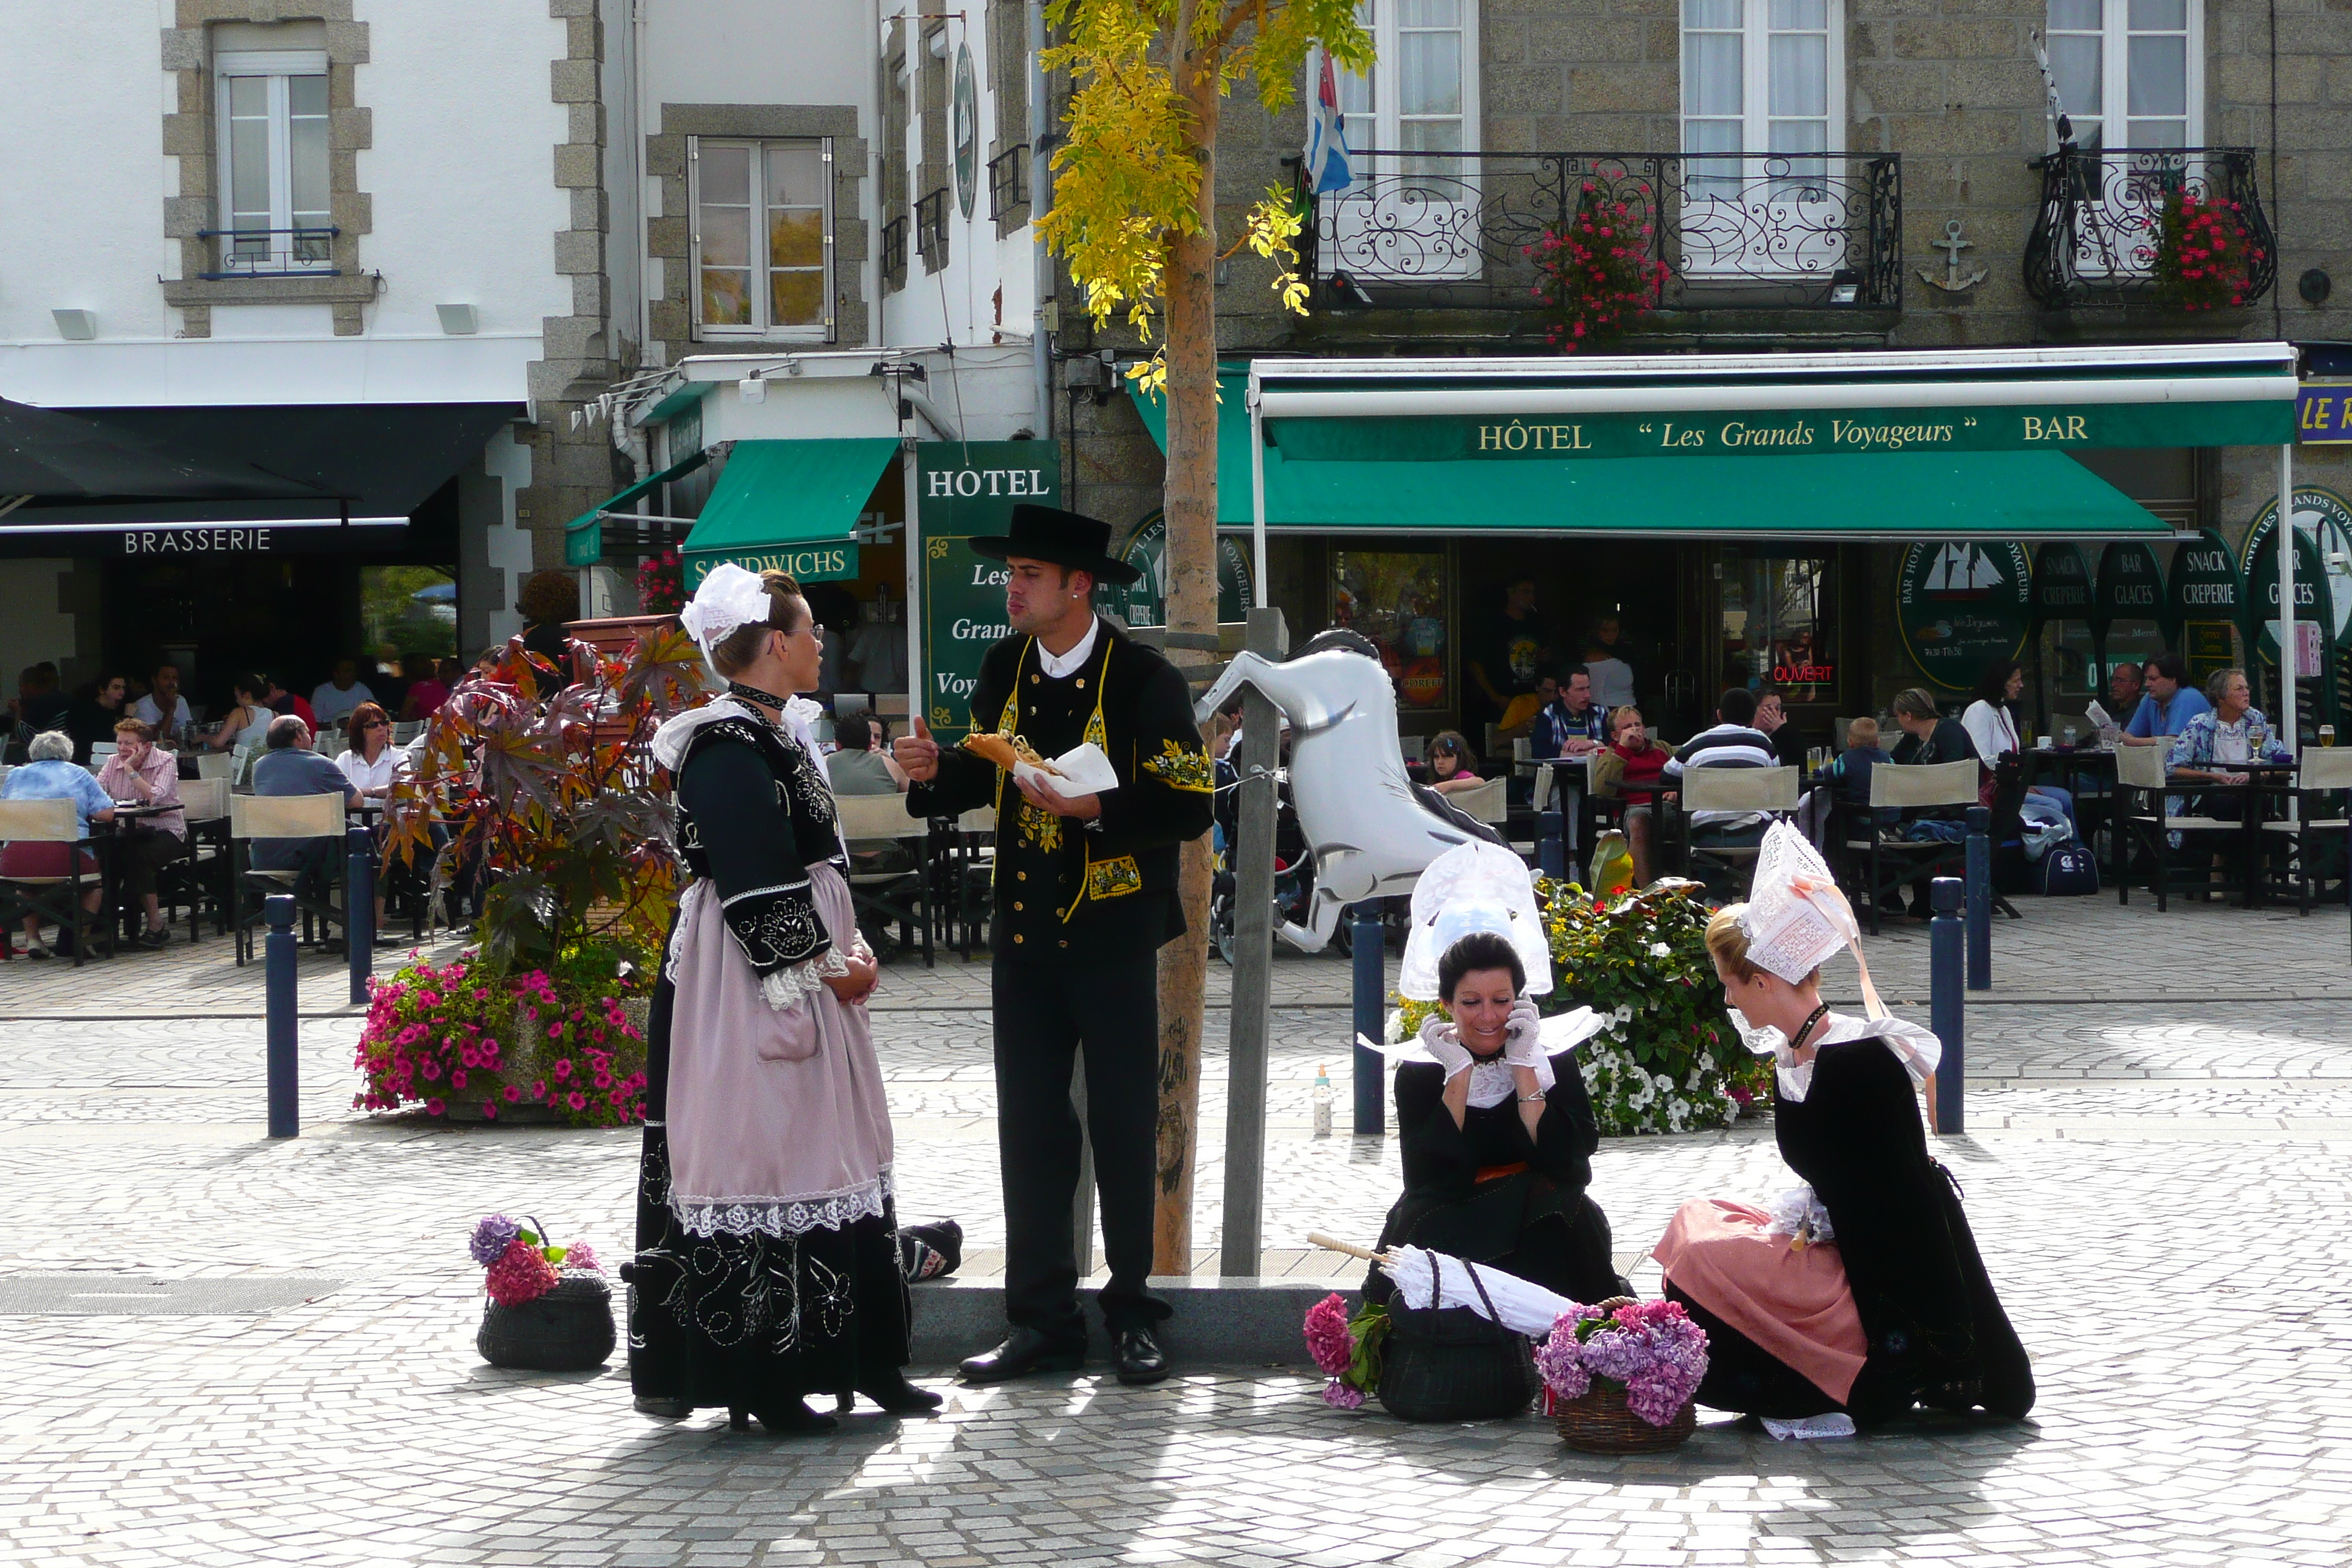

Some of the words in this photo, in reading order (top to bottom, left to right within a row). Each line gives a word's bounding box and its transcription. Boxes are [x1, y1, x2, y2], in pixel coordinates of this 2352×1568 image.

[2302, 397, 2333, 429] LE
[1478, 418, 1592, 450] HÔTEL
[1661, 423, 1705, 448] Les
[1721, 420, 1814, 446] Grands
[1831, 418, 1954, 450] Voyageurs
[2022, 415, 2089, 440] BAR
[927, 469, 1050, 497] HOTEL
[2258, 512, 2277, 534] LES
[125, 529, 271, 554] BRASSERIE
[1142, 521, 1166, 542] LES
[1221, 538, 1251, 612] VOYAGEURS
[2046, 556, 2078, 576] SNACK
[2121, 554, 2142, 573] BAR
[2187, 551, 2225, 572] SNACK
[971, 564, 1011, 586] Les
[1902, 578, 1913, 604] BAR
[2043, 586, 2087, 605] CREPERIE
[2115, 585, 2154, 605] GLACES
[2182, 583, 2235, 604] CREPERIE
[2268, 583, 2315, 605] GCES
[2131, 627, 2157, 638] Merci
[1774, 666, 1833, 681] OUVERT
